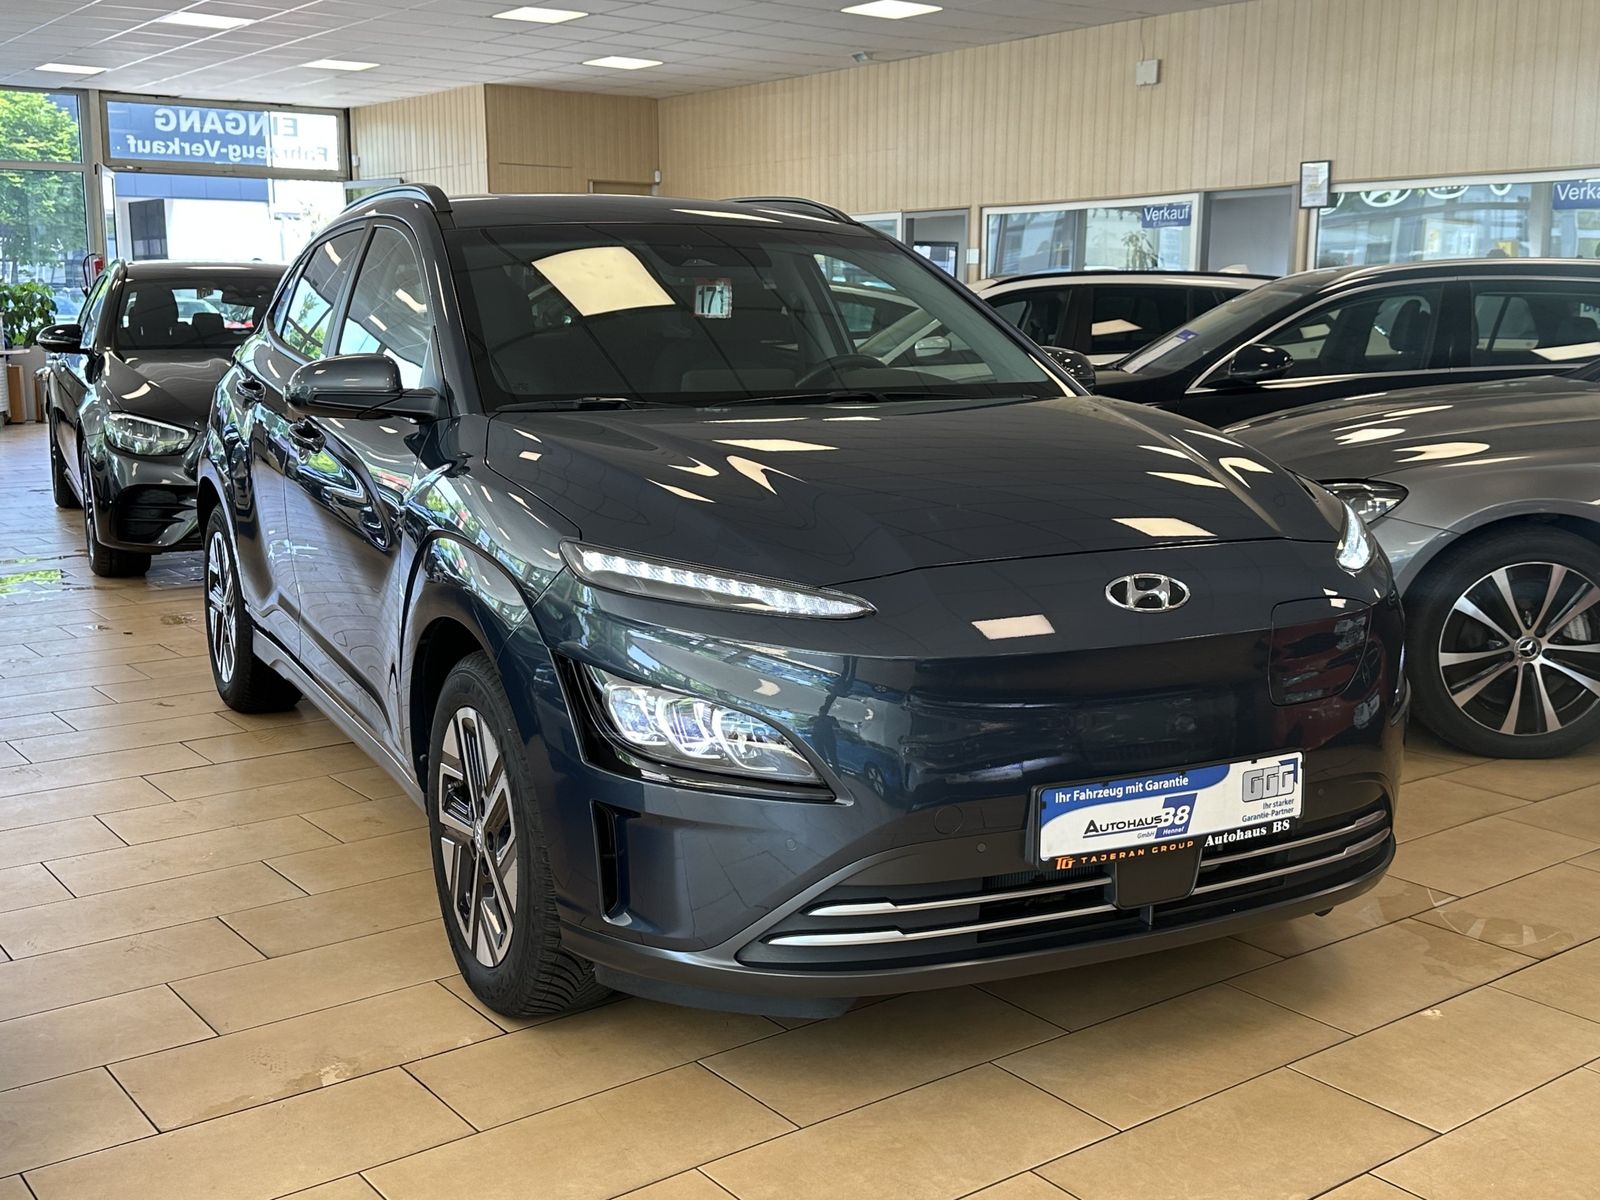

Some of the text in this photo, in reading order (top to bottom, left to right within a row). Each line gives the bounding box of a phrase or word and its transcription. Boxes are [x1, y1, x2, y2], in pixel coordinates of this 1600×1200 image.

[1144, 205, 1189, 221] Verkauf
[1055, 775, 1189, 803] Ihr Fahrzeug mit Garantie
[1262, 798, 1295, 810] Ihr starker
[1242, 806, 1295, 823] Garantie-Partner
[1137, 825, 1185, 840] GmbH Hennef
[1204, 819, 1290, 847] Autohaus B8
[1081, 848, 1145, 864] TAJERAN
[1151, 840, 1194, 854] GROUP
